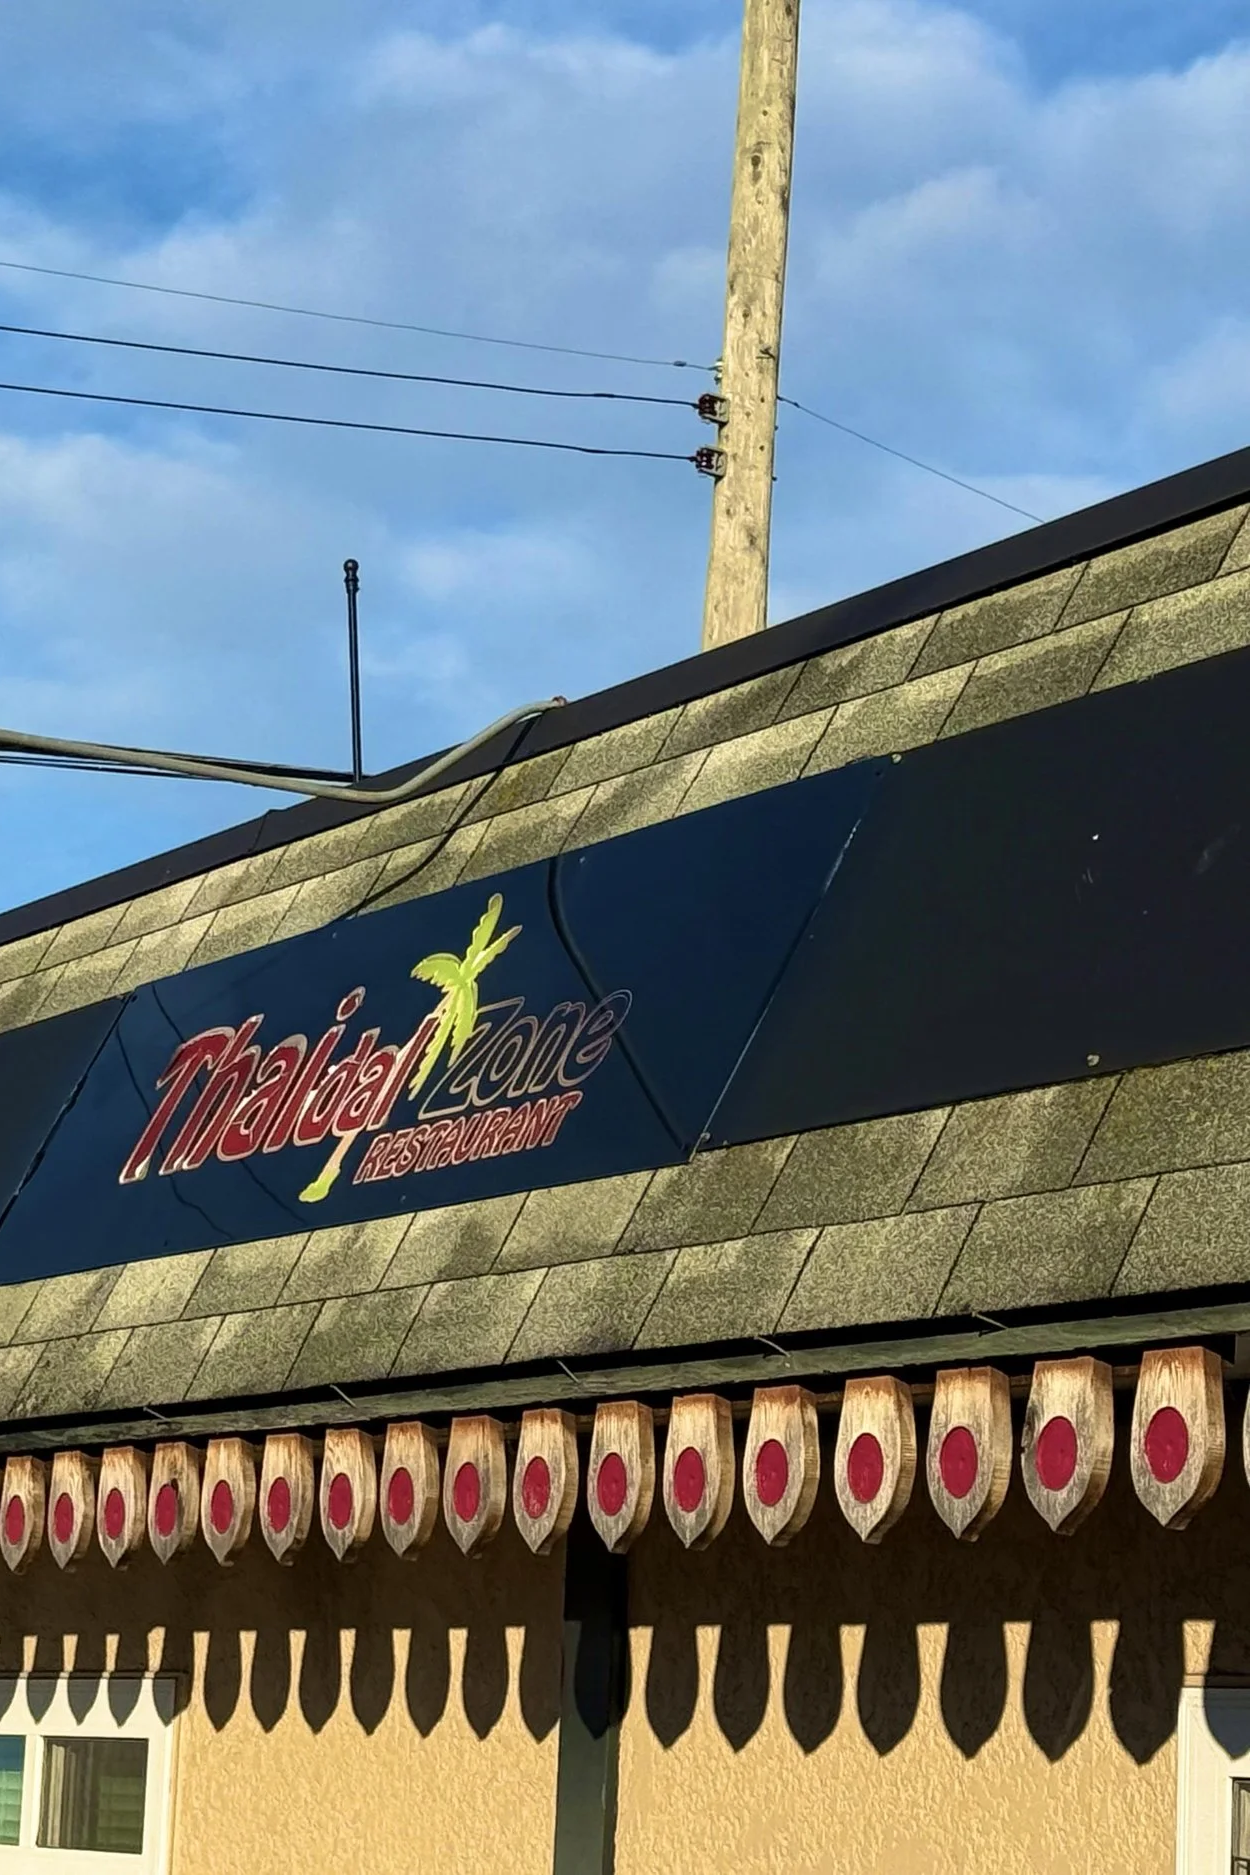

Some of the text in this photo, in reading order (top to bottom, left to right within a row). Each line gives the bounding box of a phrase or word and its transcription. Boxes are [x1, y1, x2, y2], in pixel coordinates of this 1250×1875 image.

[119, 986, 633, 1185] Thaidal Zone
[352, 1091, 583, 1185] RESTAURANT
